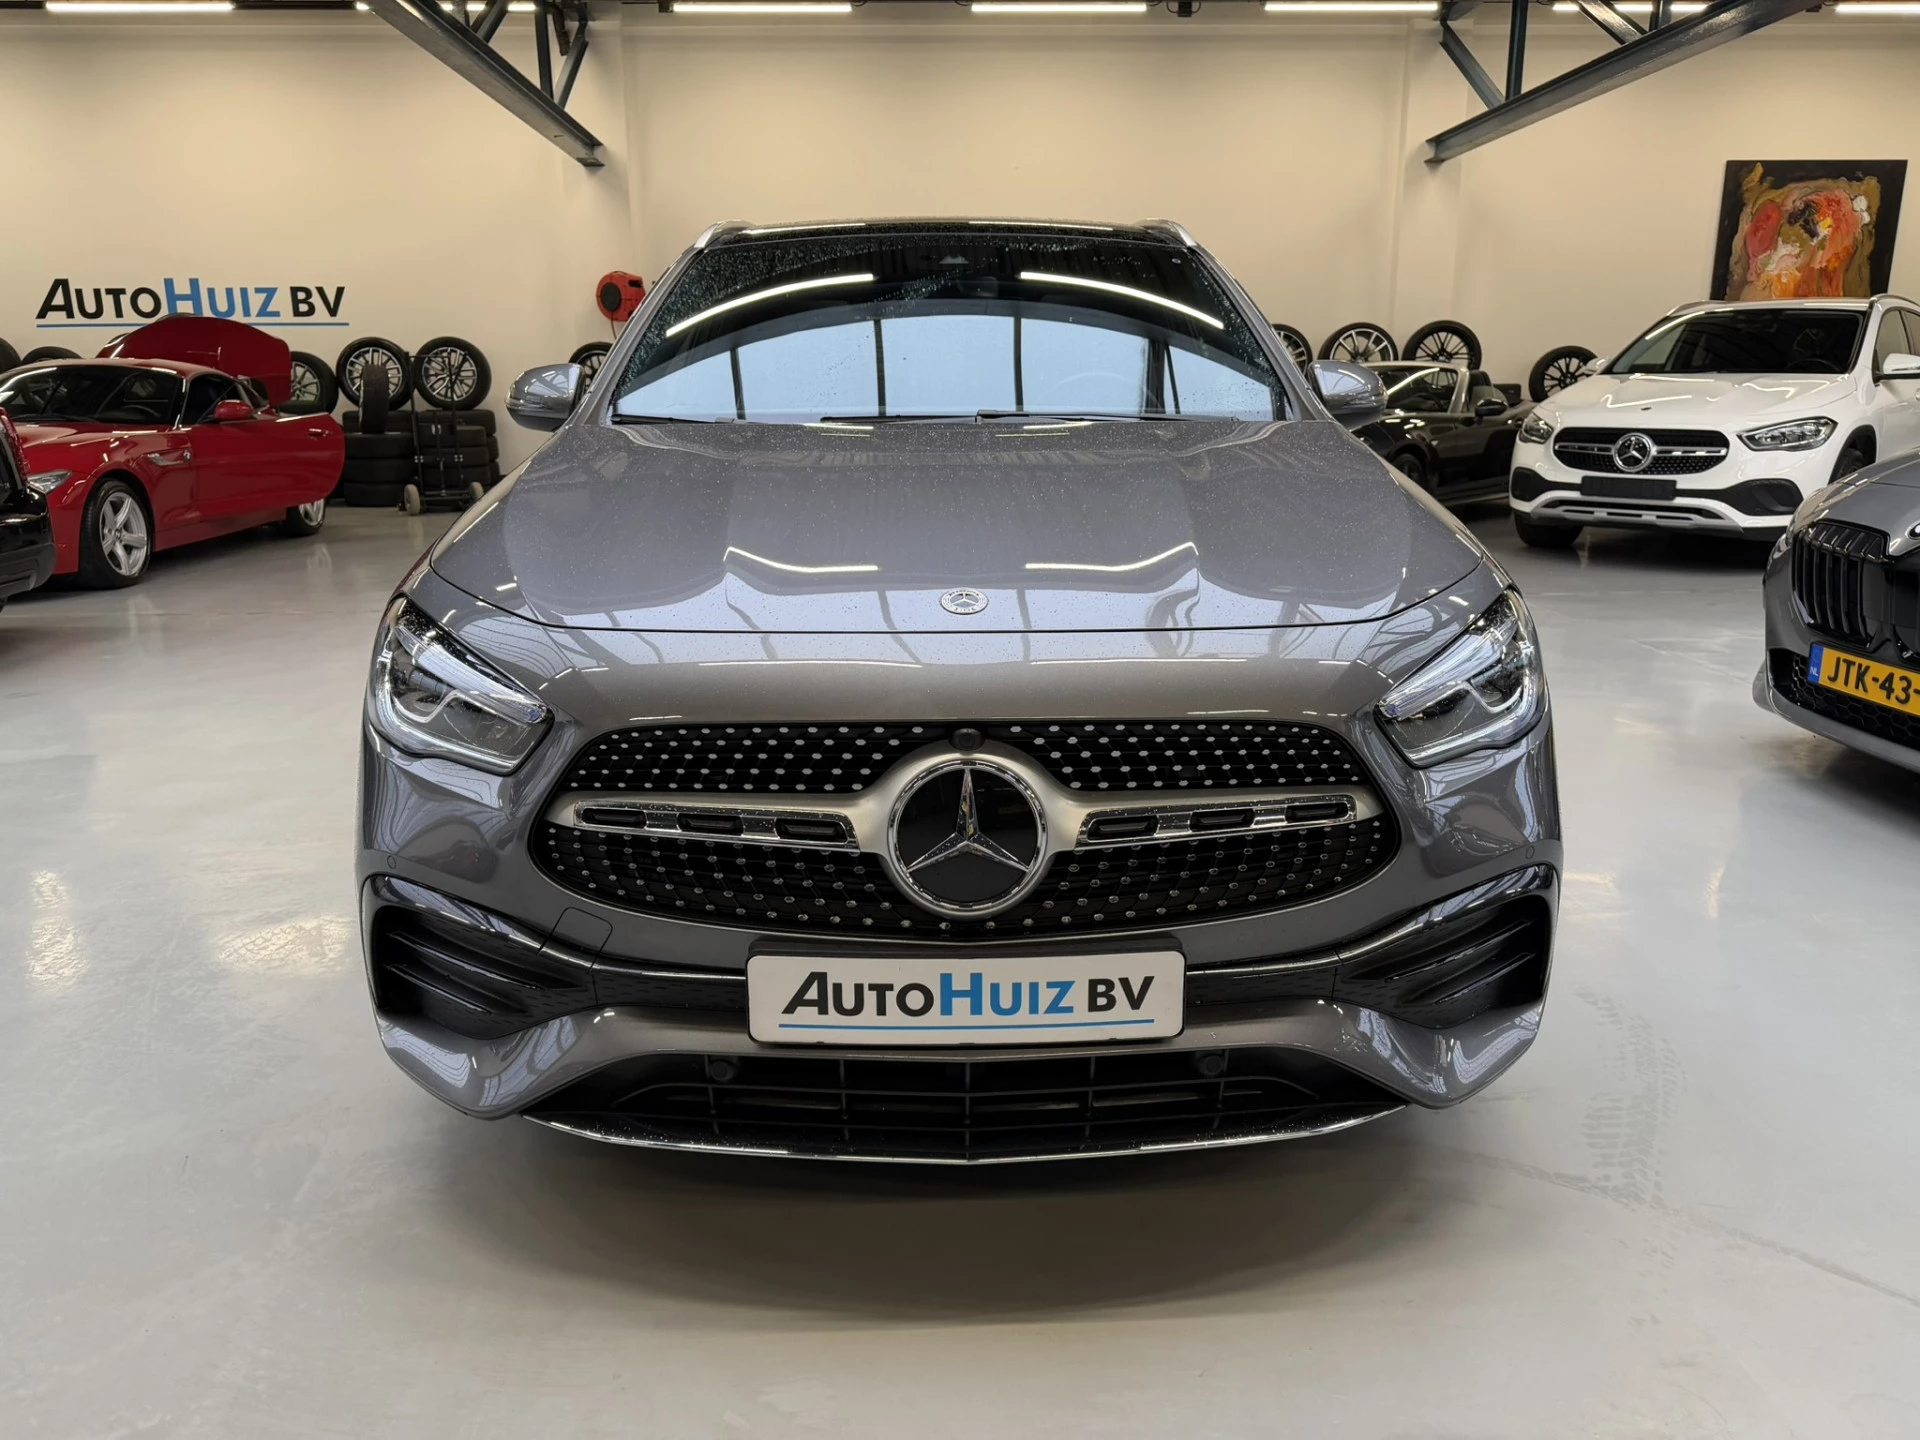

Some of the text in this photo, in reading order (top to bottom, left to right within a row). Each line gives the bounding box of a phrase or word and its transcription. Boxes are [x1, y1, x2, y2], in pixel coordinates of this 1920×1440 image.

[290, 286, 345, 318] BV
[1809, 666, 1819, 677] NL
[1087, 976, 1155, 1012] BV
